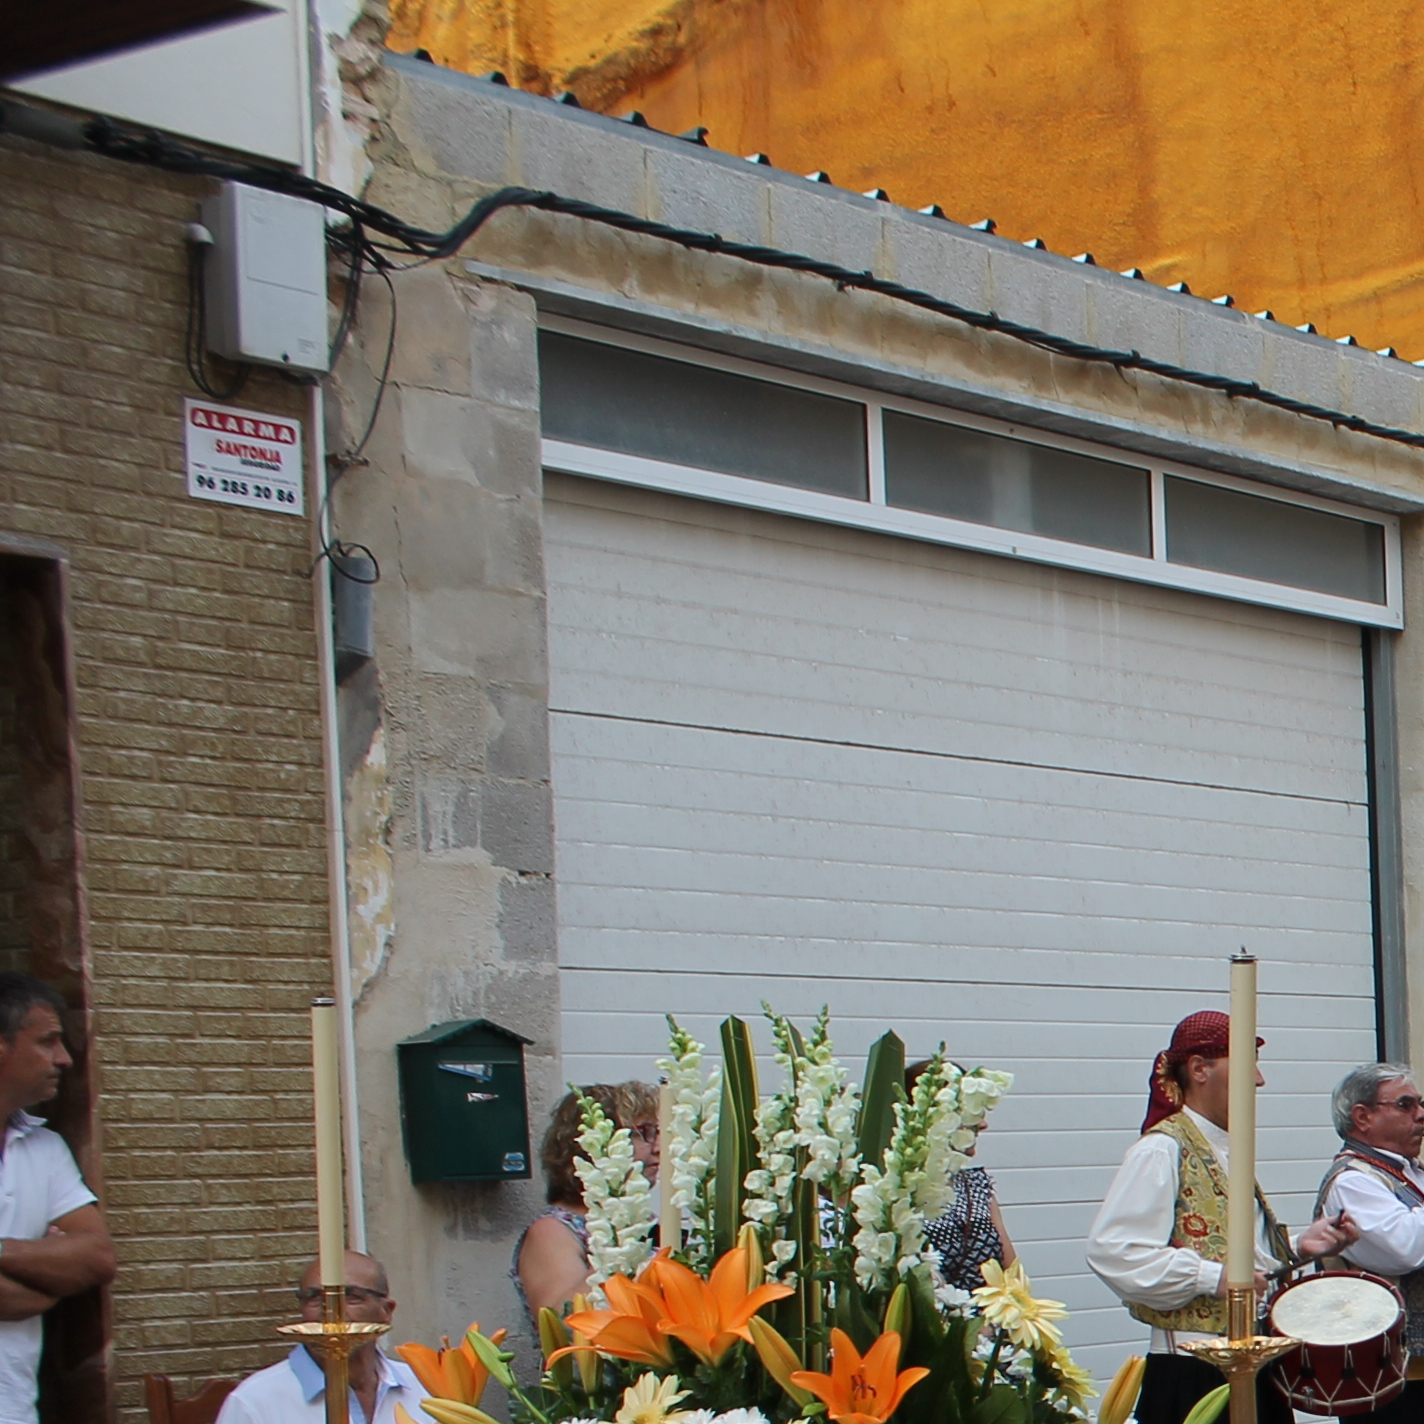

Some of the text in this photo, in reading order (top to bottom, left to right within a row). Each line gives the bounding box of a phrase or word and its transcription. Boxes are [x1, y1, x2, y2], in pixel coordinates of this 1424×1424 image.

[194, 409, 294, 443] ALARMA
[215, 439, 283, 464] SANTONJA
[196, 474, 215, 490] 96
[220, 478, 248, 496] 285
[253, 484, 272, 500] 20
[276, 488, 295, 503] 86
